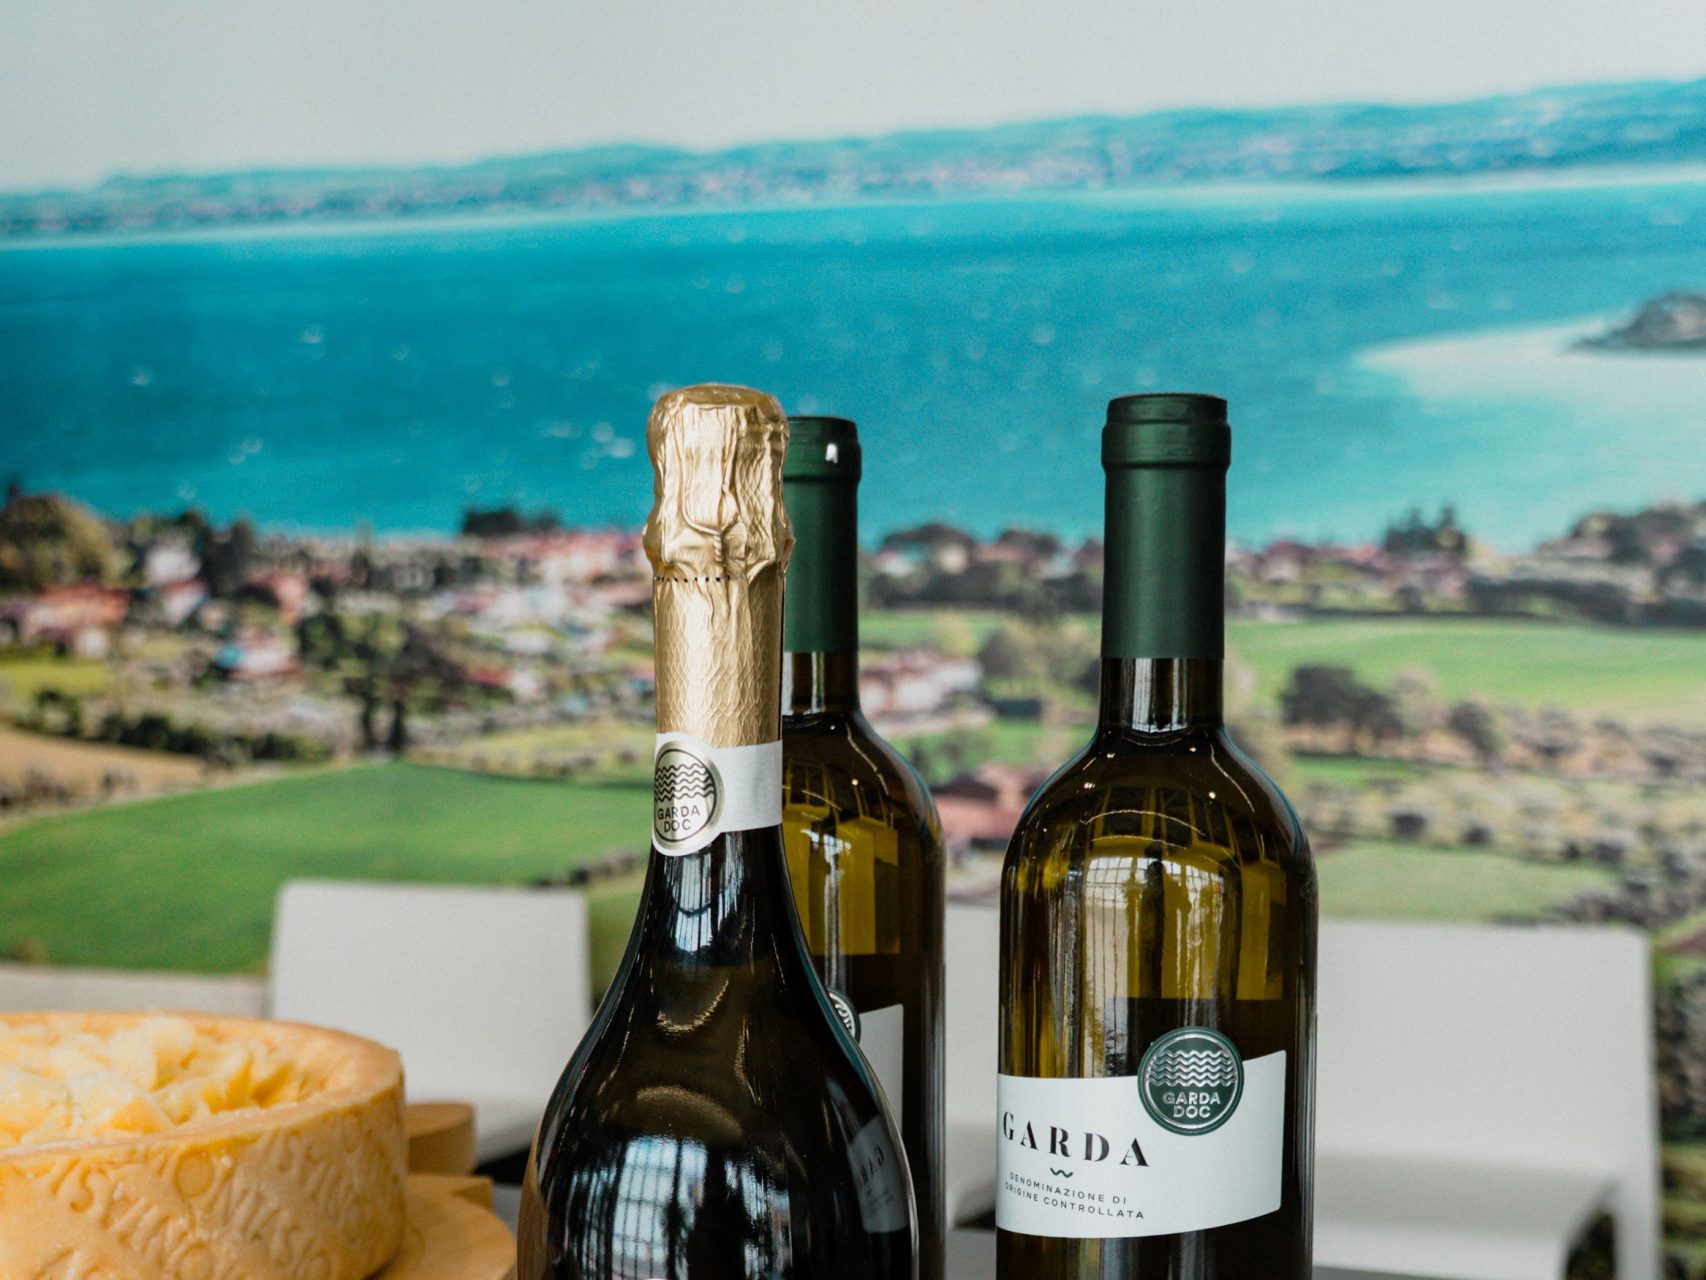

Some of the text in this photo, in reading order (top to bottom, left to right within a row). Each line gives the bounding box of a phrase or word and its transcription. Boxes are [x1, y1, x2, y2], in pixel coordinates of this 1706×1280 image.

[657, 805, 700, 820] GARDA
[664, 819, 692, 833] DOC
[1162, 1091, 1221, 1107] GARDA
[1172, 1105, 1212, 1119] DOC
[1003, 1111, 1150, 1168] GARDA
[1009, 1171, 1127, 1206] DENOMINAZIONE DI
[1043, 1195, 1145, 1220] CONTROLLATA
